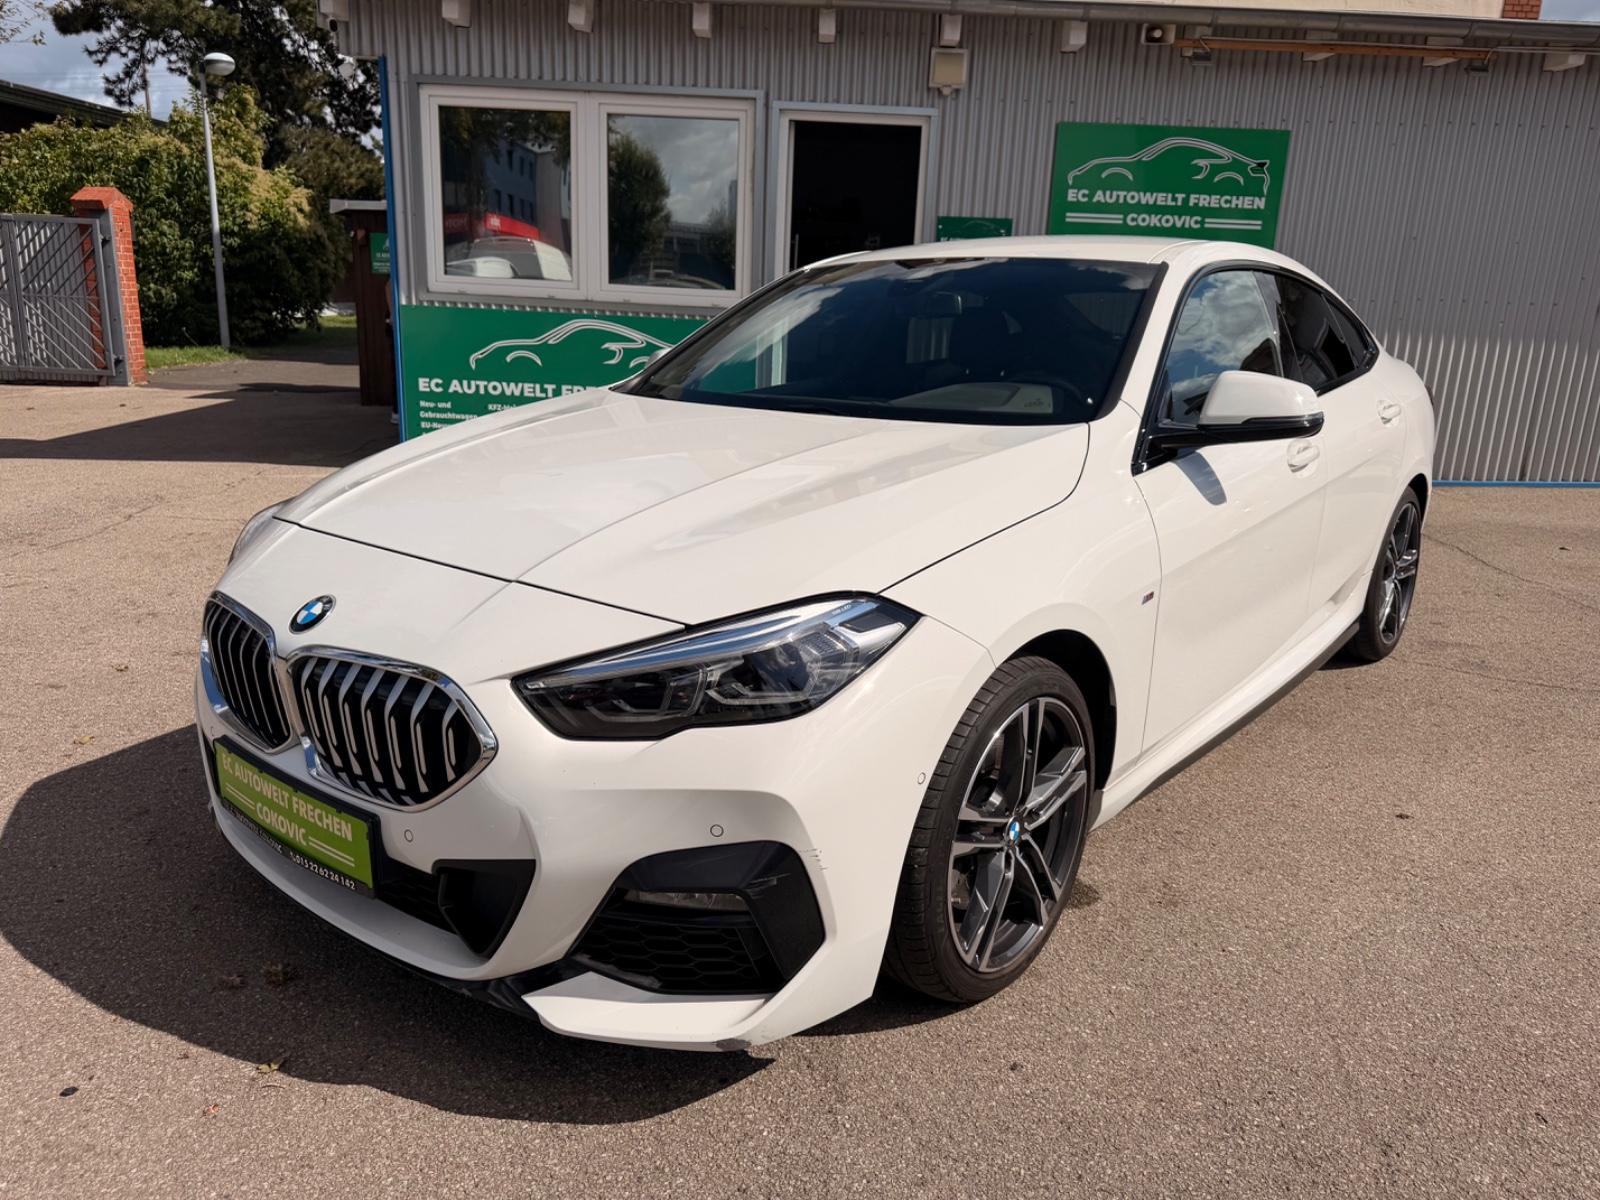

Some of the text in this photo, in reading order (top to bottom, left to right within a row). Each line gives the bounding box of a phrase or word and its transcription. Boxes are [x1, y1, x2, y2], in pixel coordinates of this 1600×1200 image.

[1067, 189, 1266, 210] EC AUTOWELT FRECHEN
[1126, 213, 1202, 229] COKOVIC
[418, 378, 443, 392] EC
[449, 380, 556, 398] AUTOWELT
[438, 401, 452, 409] und
[223, 755, 233, 774] EC
[235, 764, 290, 809] AUTOWELT
[292, 798, 353, 842] FRECHEN
[256, 803, 307, 846] COKOVIC
